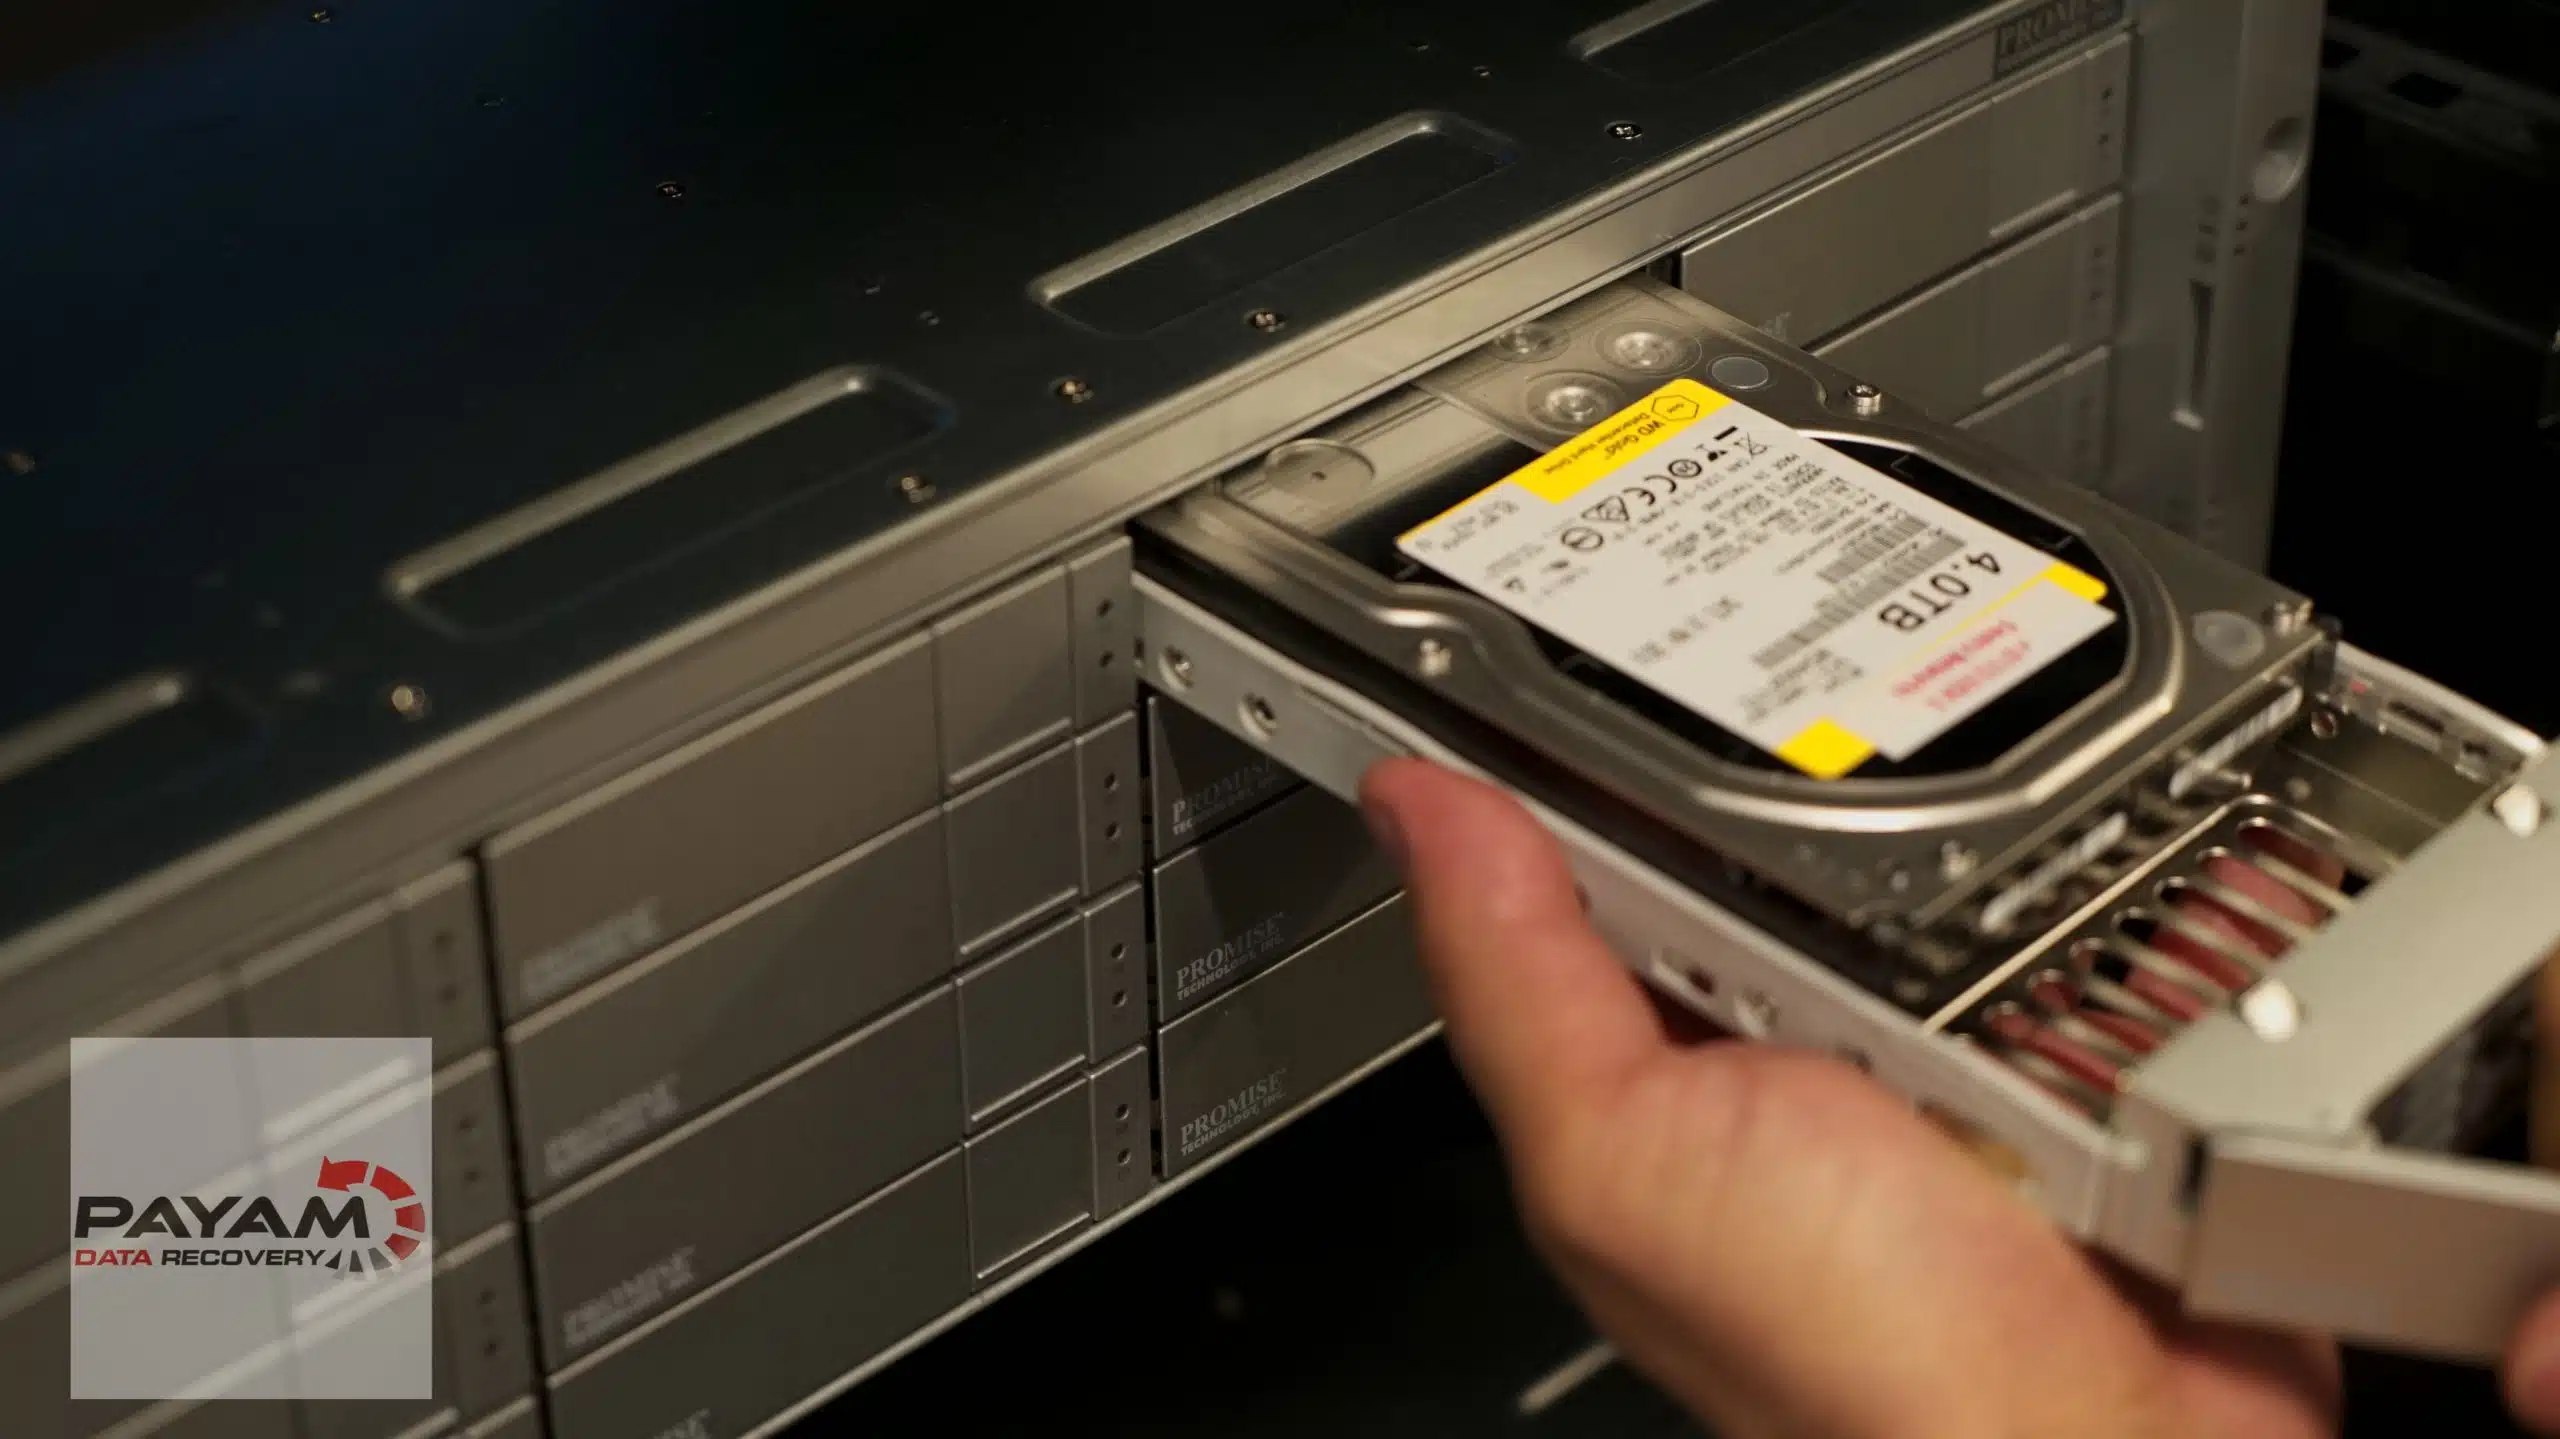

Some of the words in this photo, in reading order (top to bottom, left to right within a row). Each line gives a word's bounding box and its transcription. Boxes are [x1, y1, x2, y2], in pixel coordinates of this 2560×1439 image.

[1635, 418, 1665, 437] WD
[1879, 550, 2001, 632] 4.0TB
[1181, 1072, 1282, 1146] PROMISE
